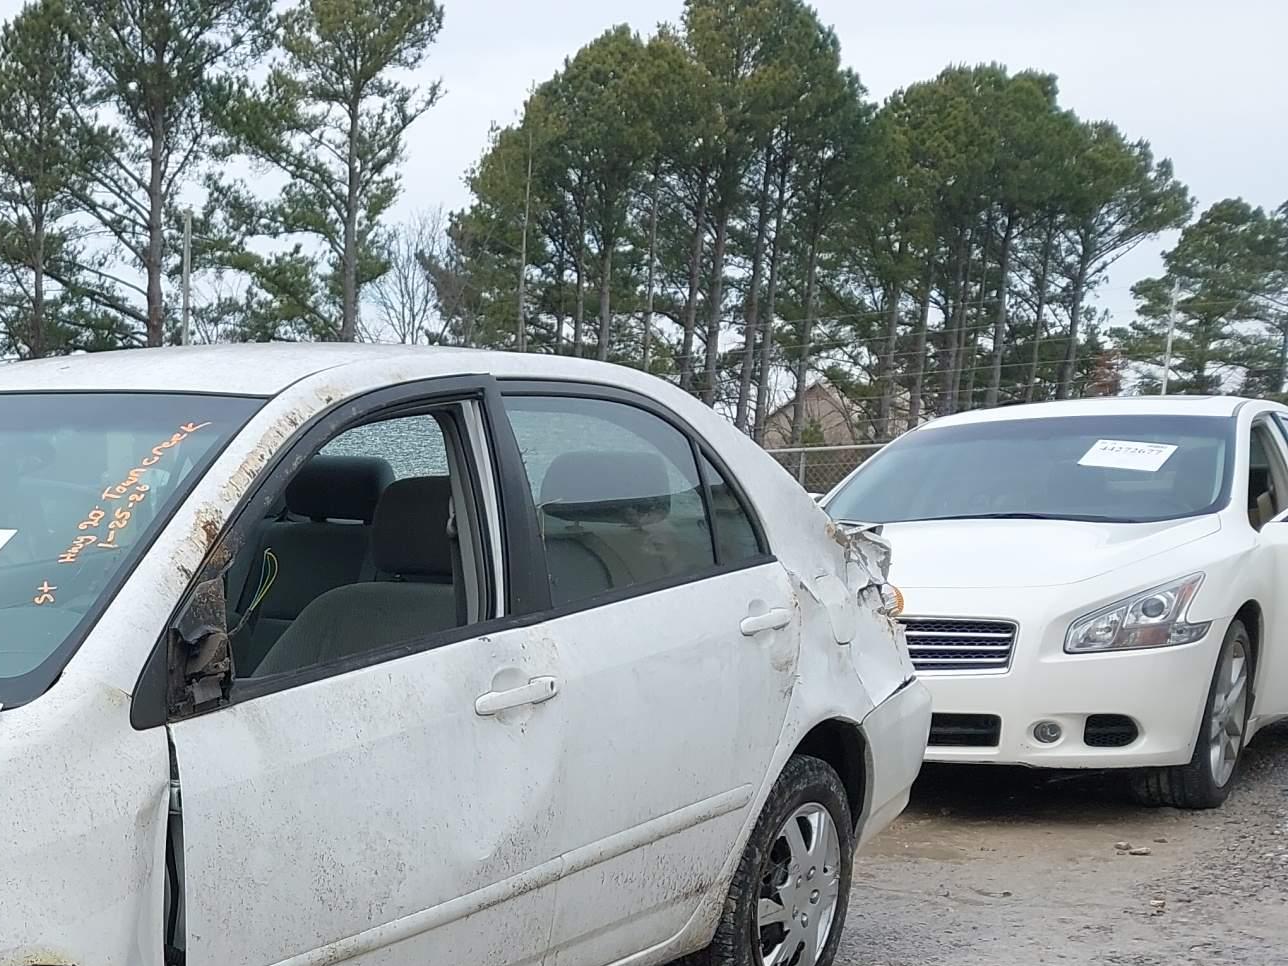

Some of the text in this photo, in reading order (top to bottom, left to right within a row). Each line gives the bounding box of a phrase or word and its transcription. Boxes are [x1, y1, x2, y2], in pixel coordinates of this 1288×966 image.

[58, 535, 97, 562] Hwy
[102, 468, 147, 499] Town
[97, 484, 150, 548] 1-25-26
